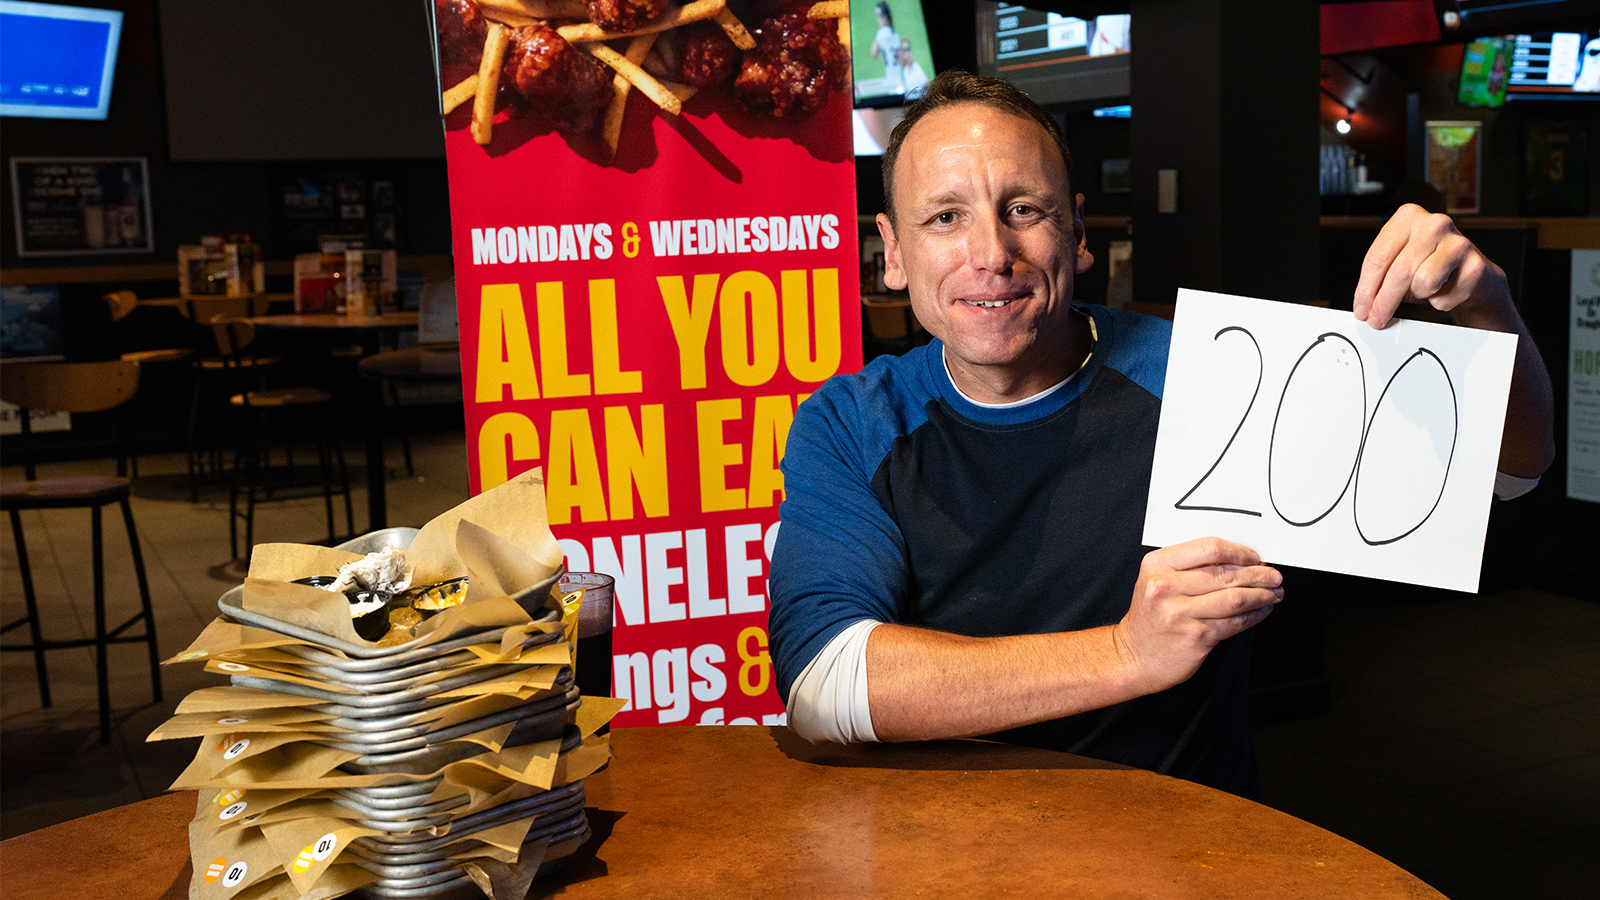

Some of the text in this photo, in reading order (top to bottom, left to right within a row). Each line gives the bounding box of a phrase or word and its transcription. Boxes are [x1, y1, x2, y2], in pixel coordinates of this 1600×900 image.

[471, 214, 840, 265] MONDAYS & WEDNESDAYS
[475, 268, 842, 404] ALL YOU
[478, 394, 812, 525] CAN EA
[1174, 325, 1458, 546] 200
[612, 626, 773, 724] ngs &
[228, 867, 243, 882] 10
[318, 839, 332, 854] 10
